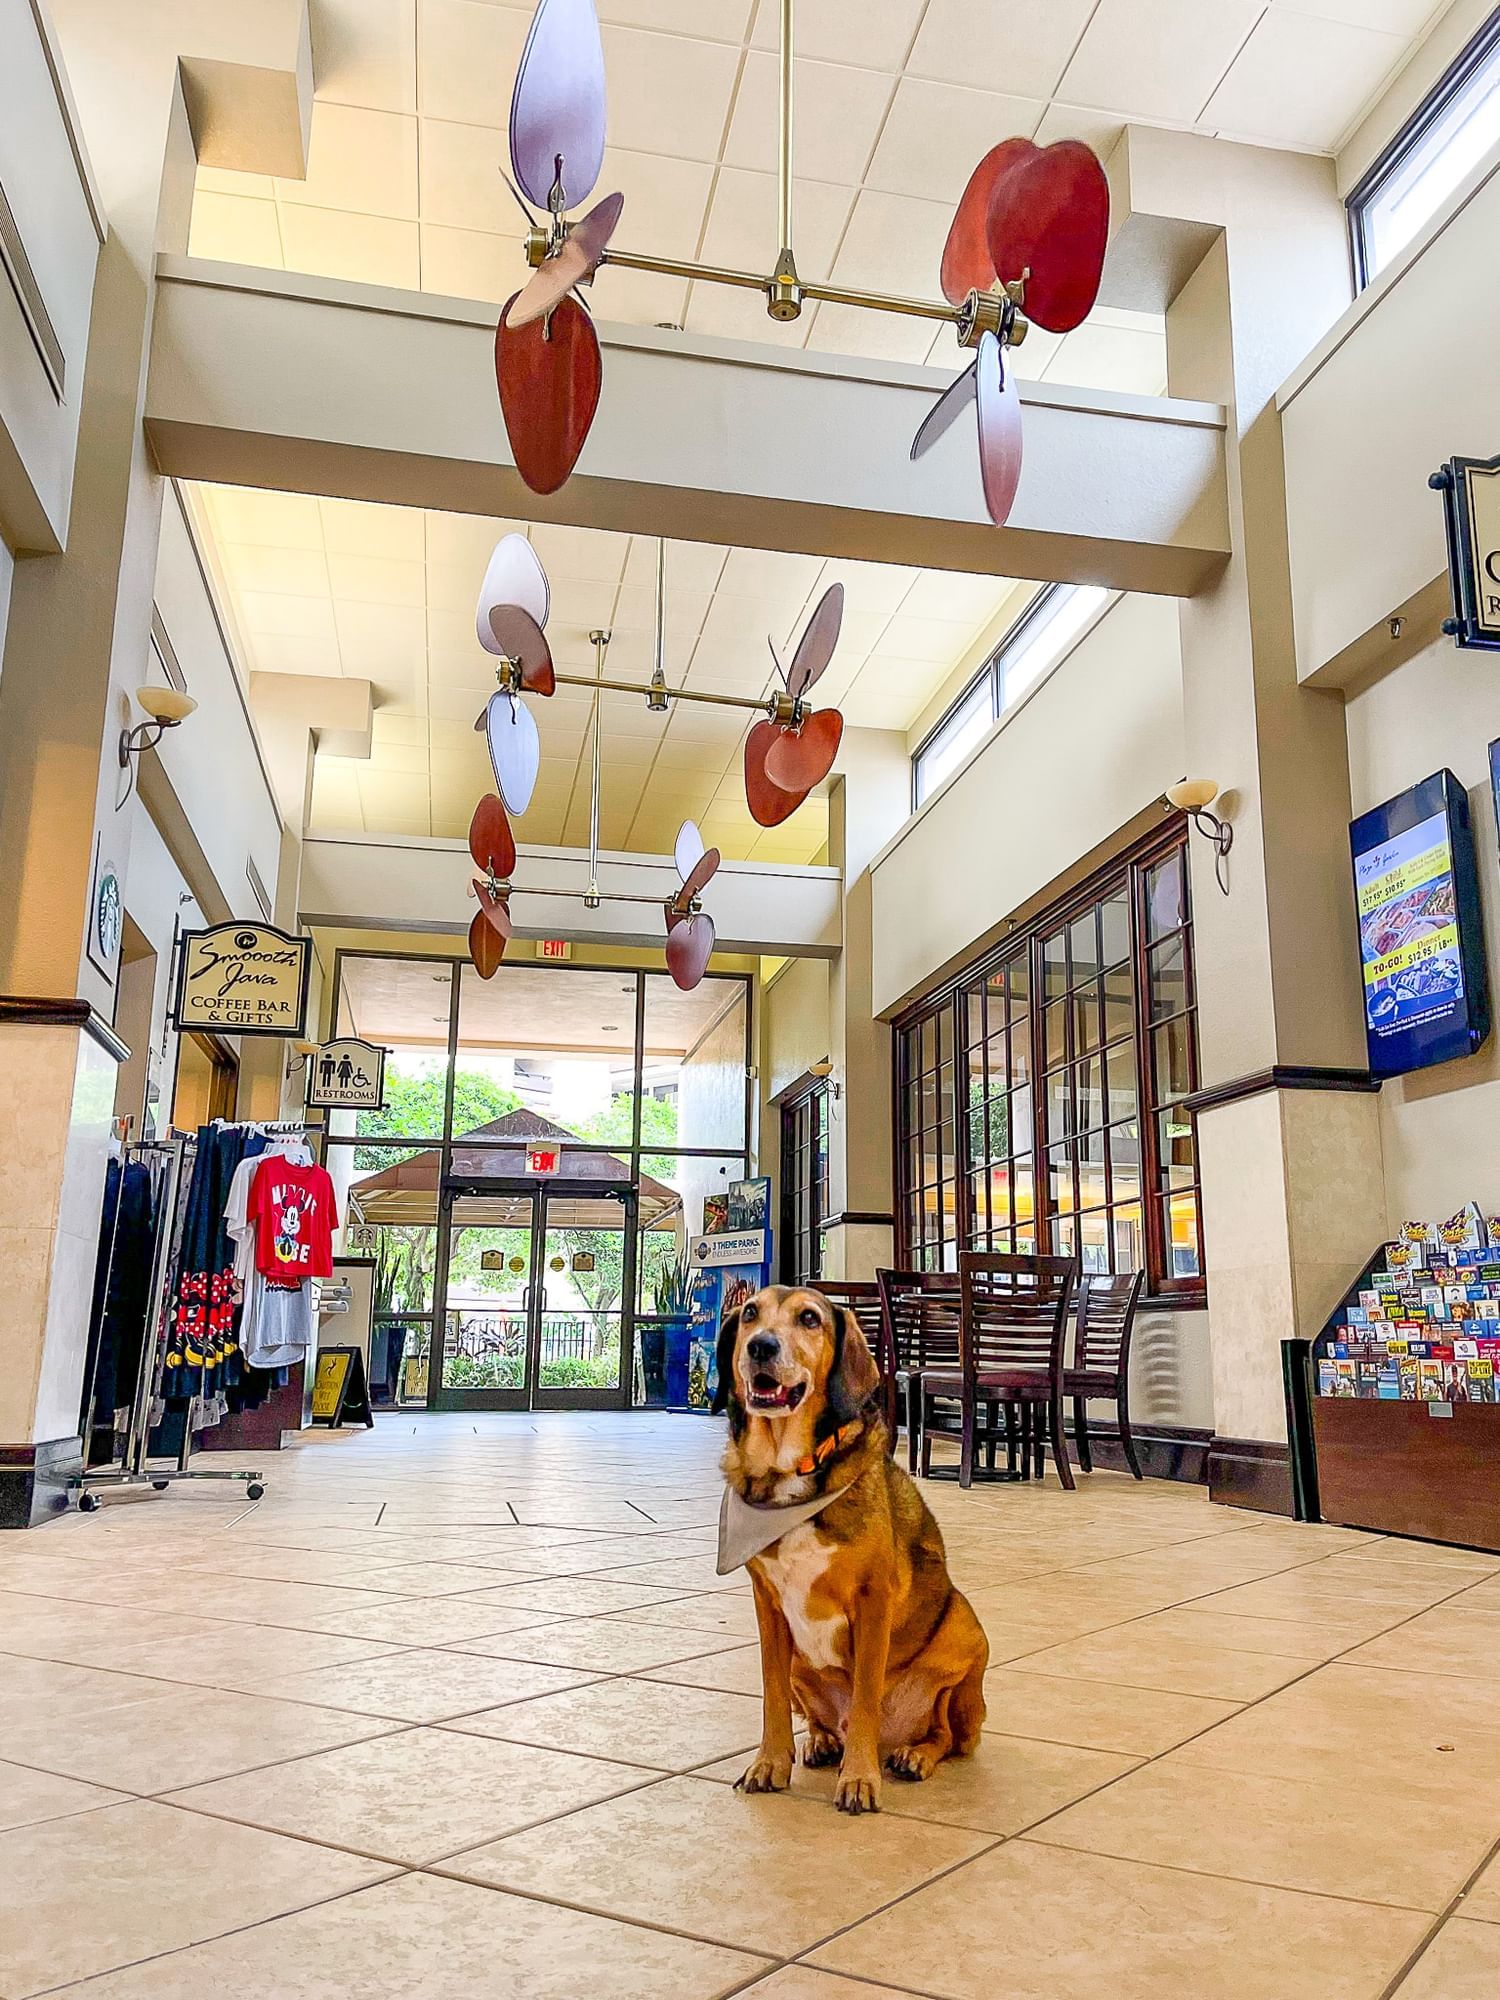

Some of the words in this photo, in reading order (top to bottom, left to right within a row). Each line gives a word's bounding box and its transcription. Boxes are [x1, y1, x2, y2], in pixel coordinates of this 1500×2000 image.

[544, 941, 566, 957] EXIT
[217, 962, 279, 997] Java
[191, 996, 251, 1010] COFFEE
[257, 1000, 292, 1012] BAR
[208, 1011, 221, 1021] &
[226, 1011, 273, 1023] GIFTS
[315, 1089, 375, 1100] RESTROOMS
[718, 1240, 738, 1250] THEME
